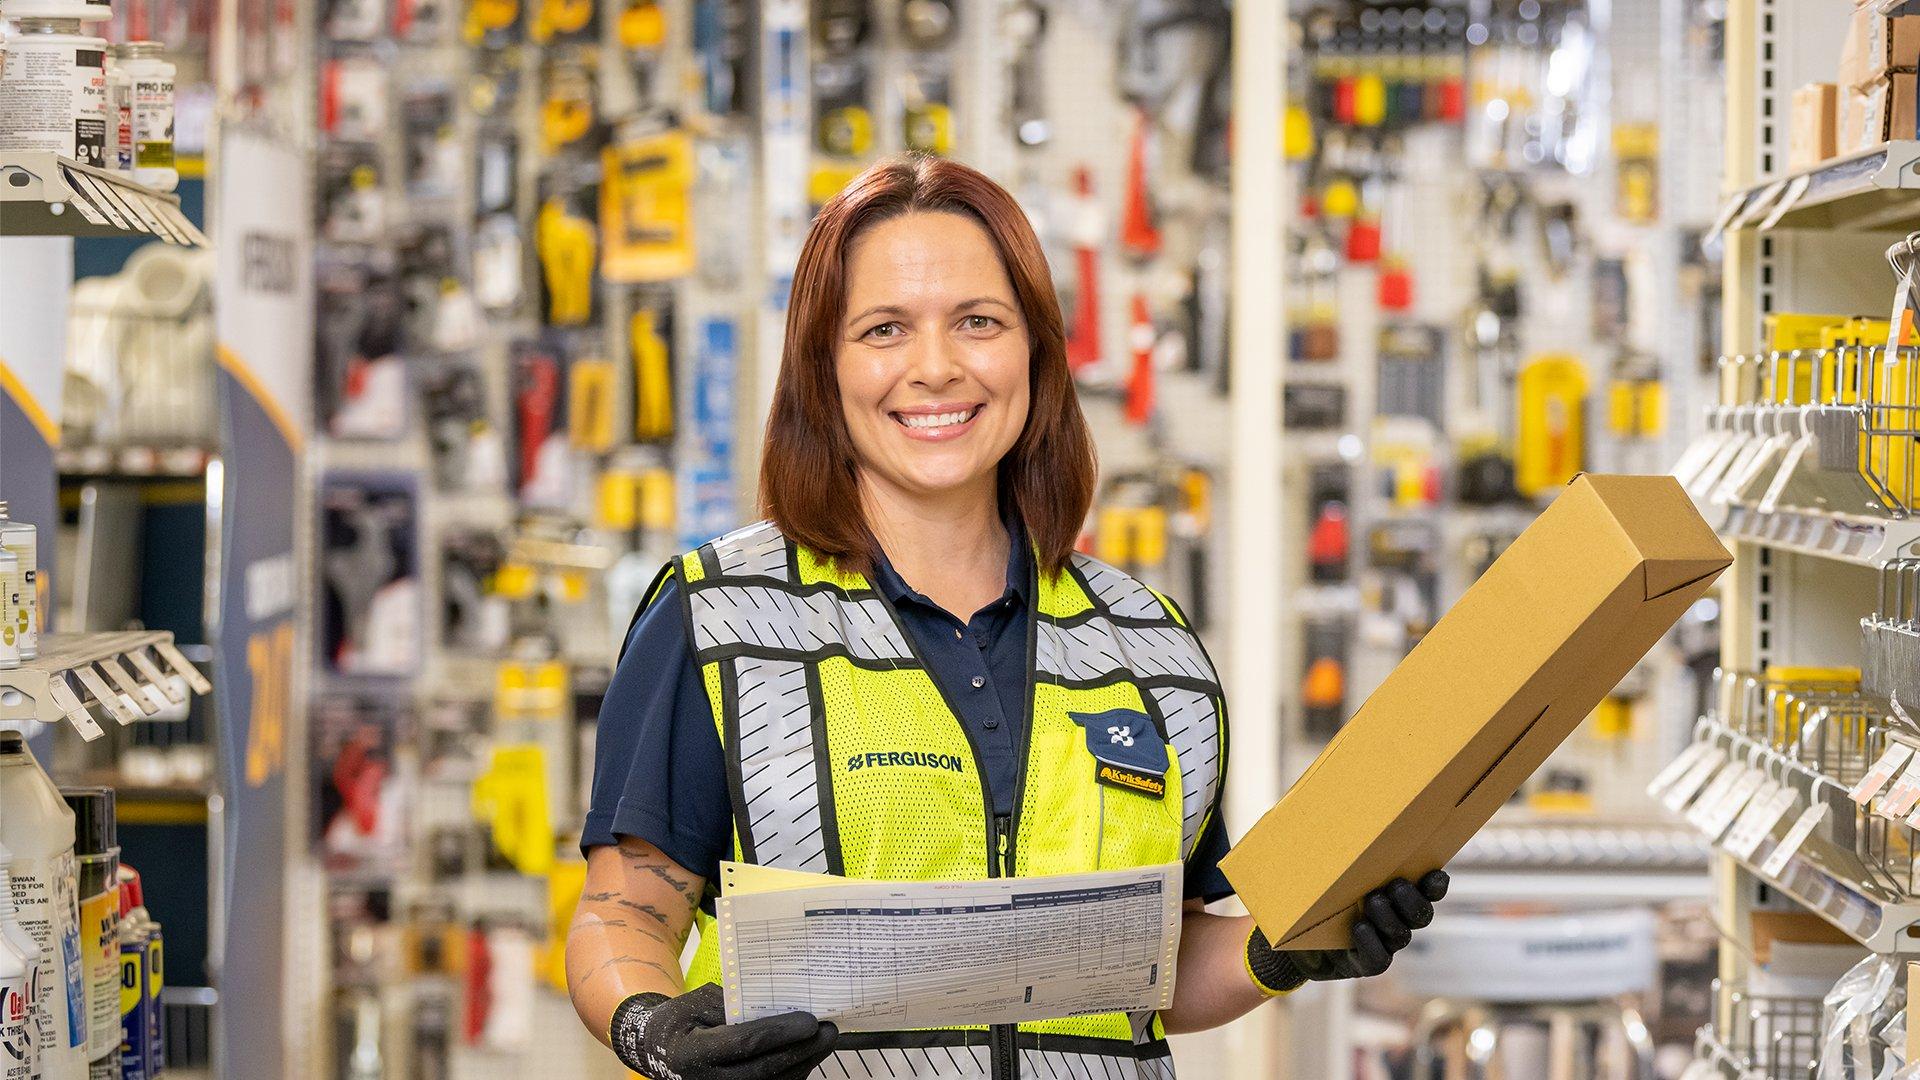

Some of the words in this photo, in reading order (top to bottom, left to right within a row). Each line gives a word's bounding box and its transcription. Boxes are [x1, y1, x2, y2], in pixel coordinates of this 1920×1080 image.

[137, 82, 158, 92] PRO
[865, 751, 963, 773] FERGUSON
[1112, 769, 1163, 792] KwikSafety
[1068, 1006, 1137, 1016] FERGUSON
